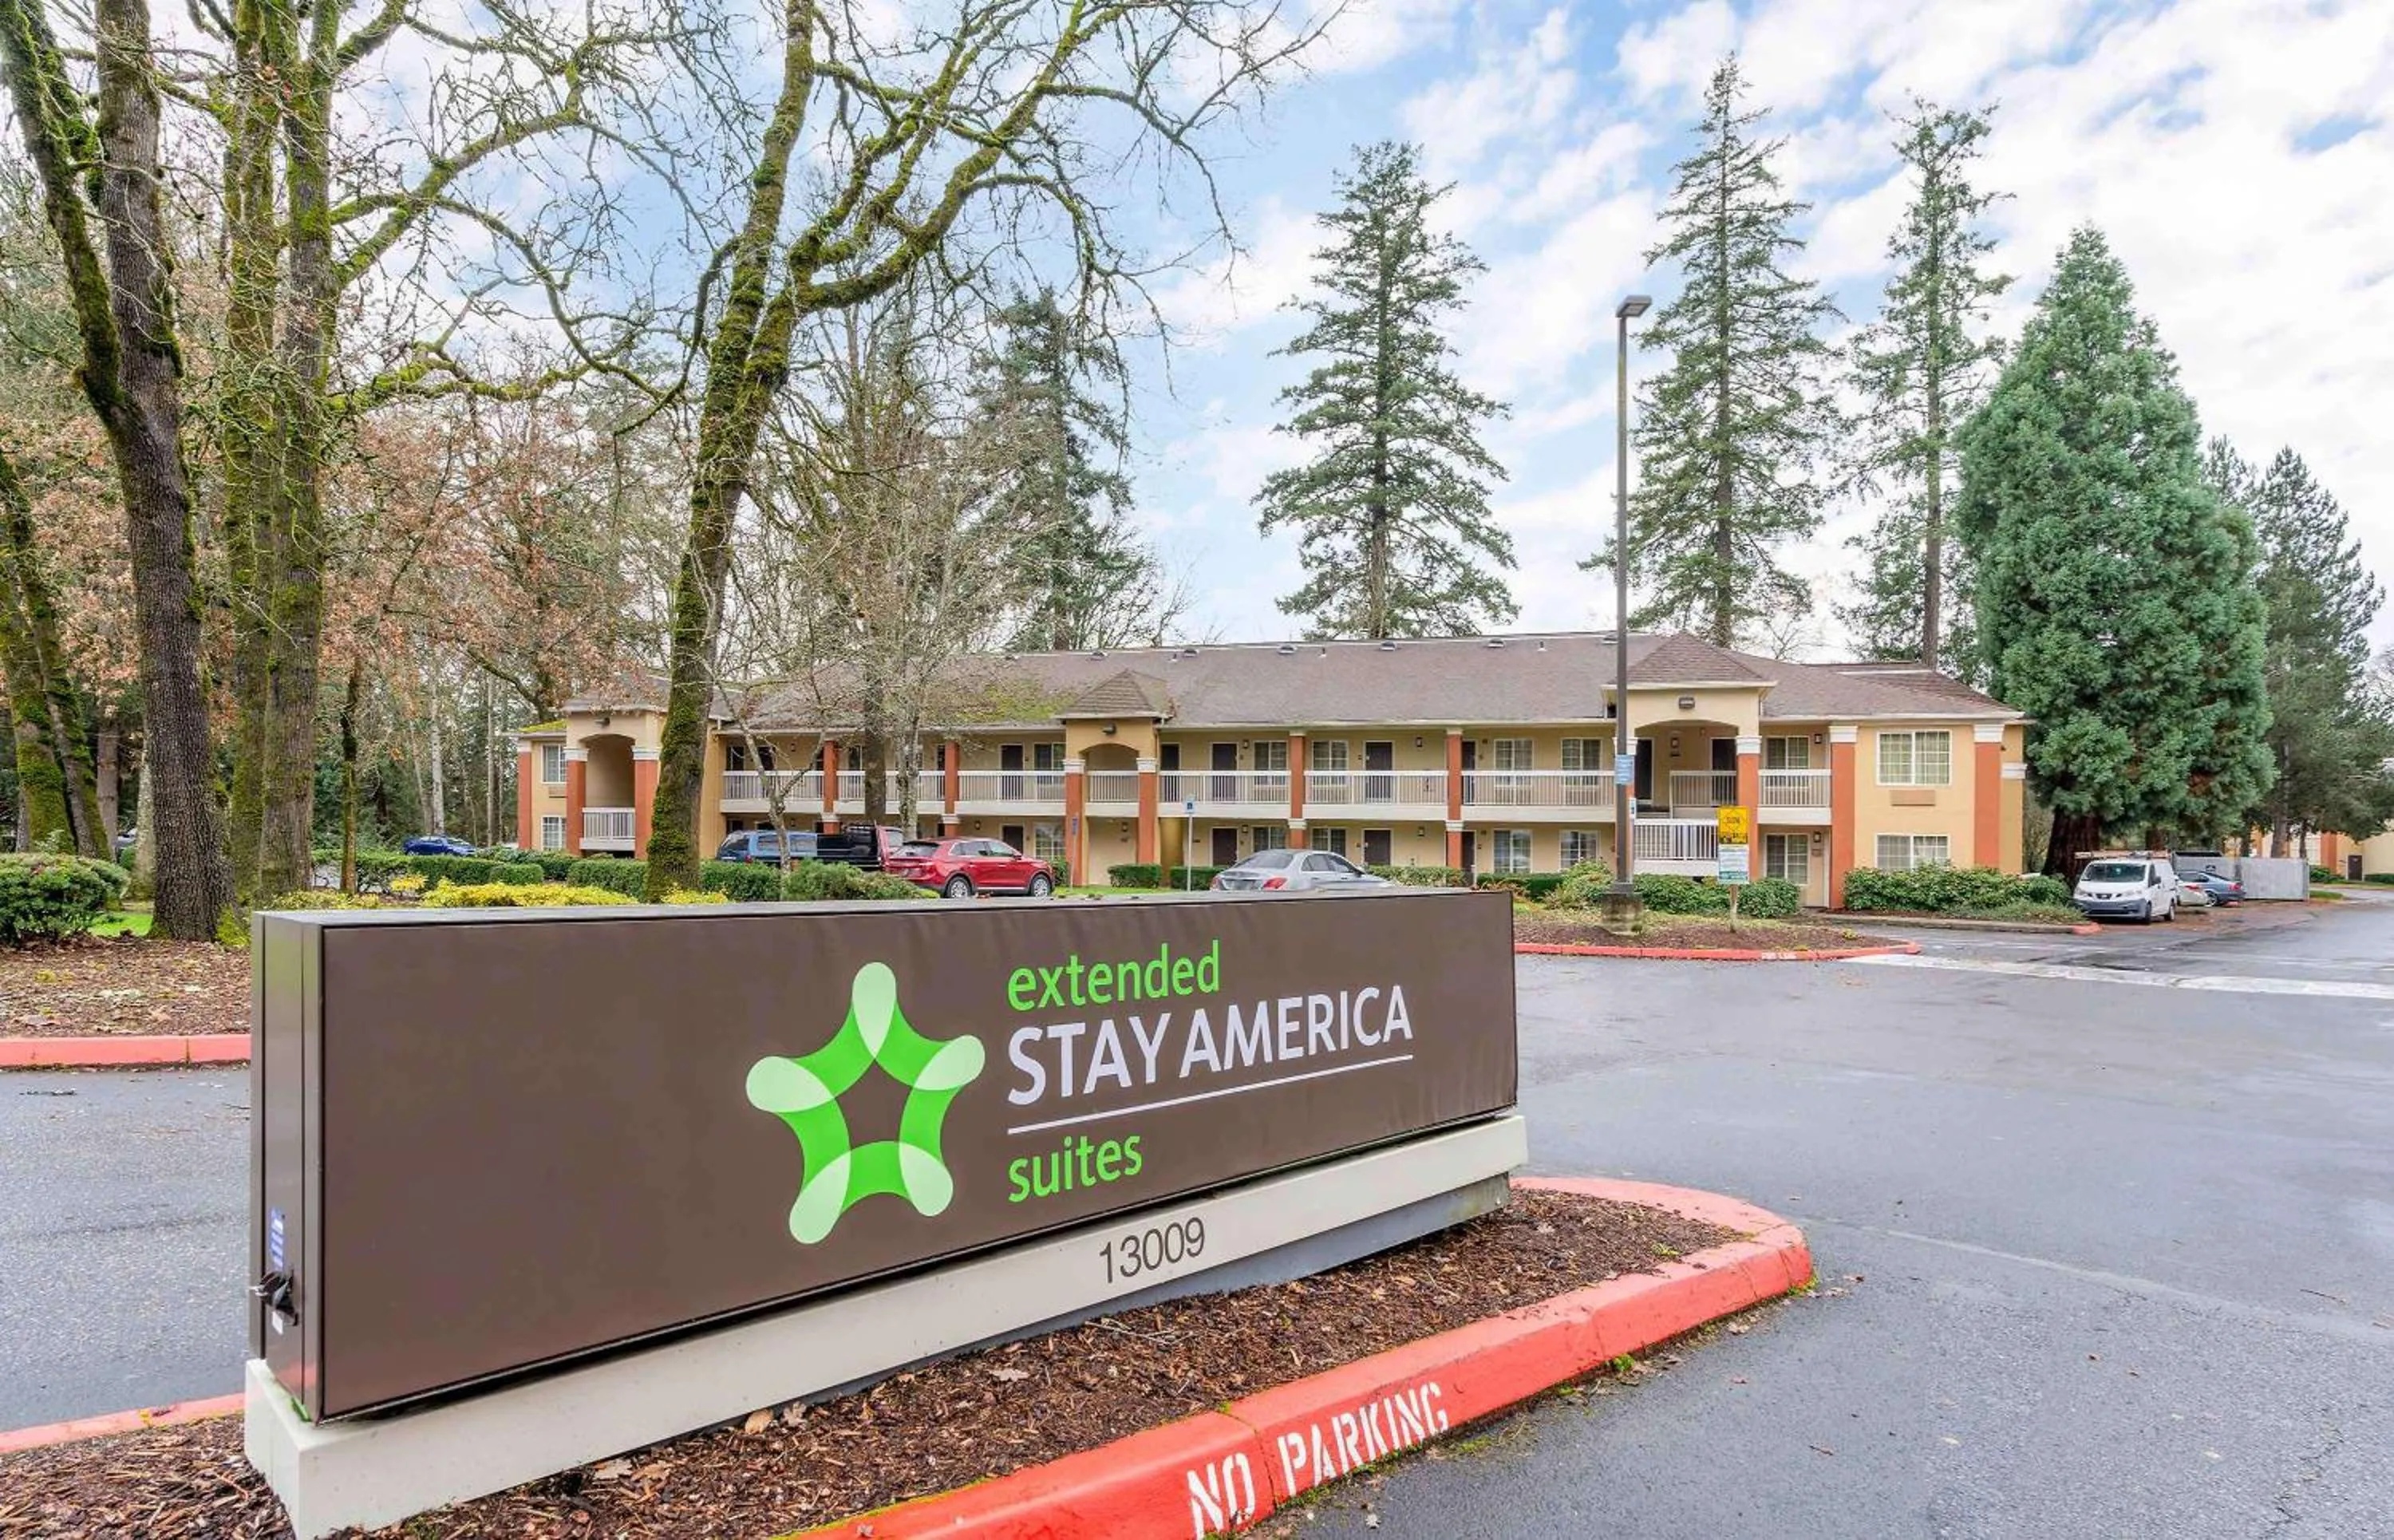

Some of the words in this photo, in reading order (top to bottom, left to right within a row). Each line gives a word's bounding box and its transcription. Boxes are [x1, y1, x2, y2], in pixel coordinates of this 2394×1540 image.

[1008, 939, 1219, 1010] extended
[1009, 1013, 1171, 1104] STAY
[1179, 985, 1413, 1078] AMERICA
[1009, 1135, 1142, 1202] suites
[1099, 1217, 1206, 1283] 13009
[1187, 1452, 1256, 1539] NO
[1278, 1381, 1448, 1496] PARKING
